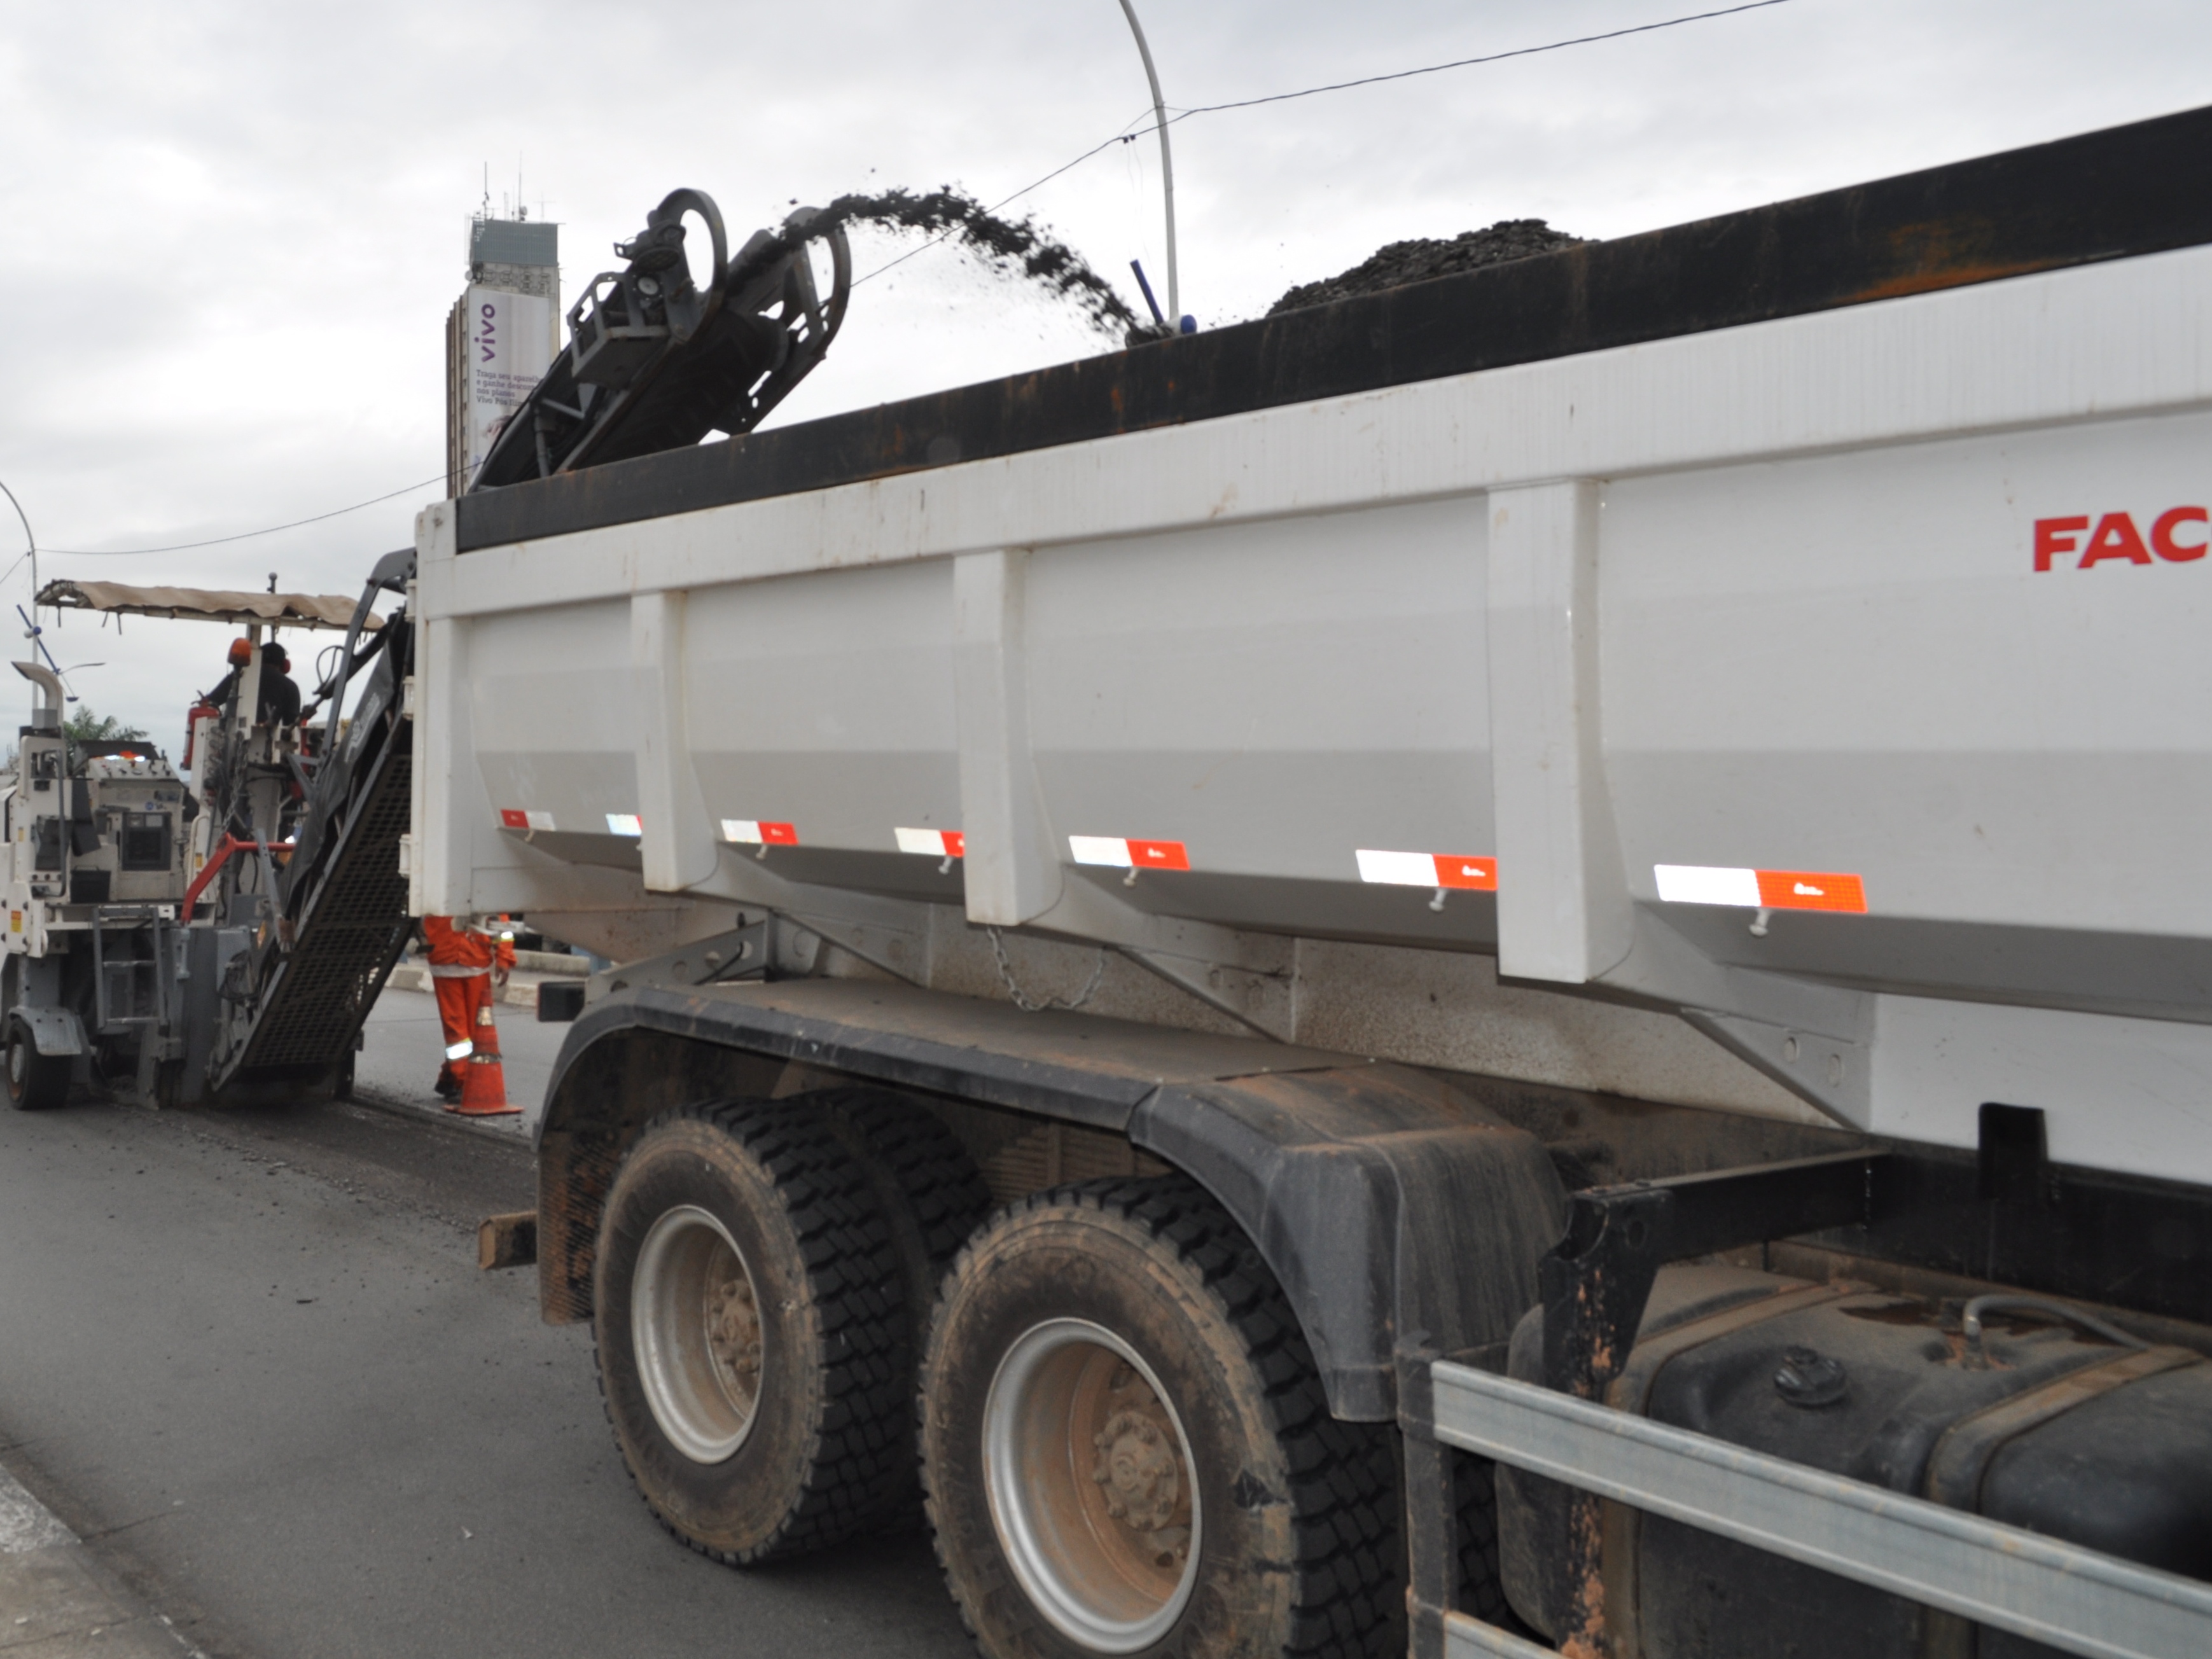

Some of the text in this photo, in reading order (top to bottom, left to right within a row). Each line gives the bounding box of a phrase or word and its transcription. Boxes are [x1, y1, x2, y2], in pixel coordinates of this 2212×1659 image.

[474, 303, 496, 363] vivo
[476, 370, 496, 380] Traga
[491, 388, 515, 397] planos
[476, 395, 493, 404] Vivo
[2033, 505, 2208, 573] FAC
